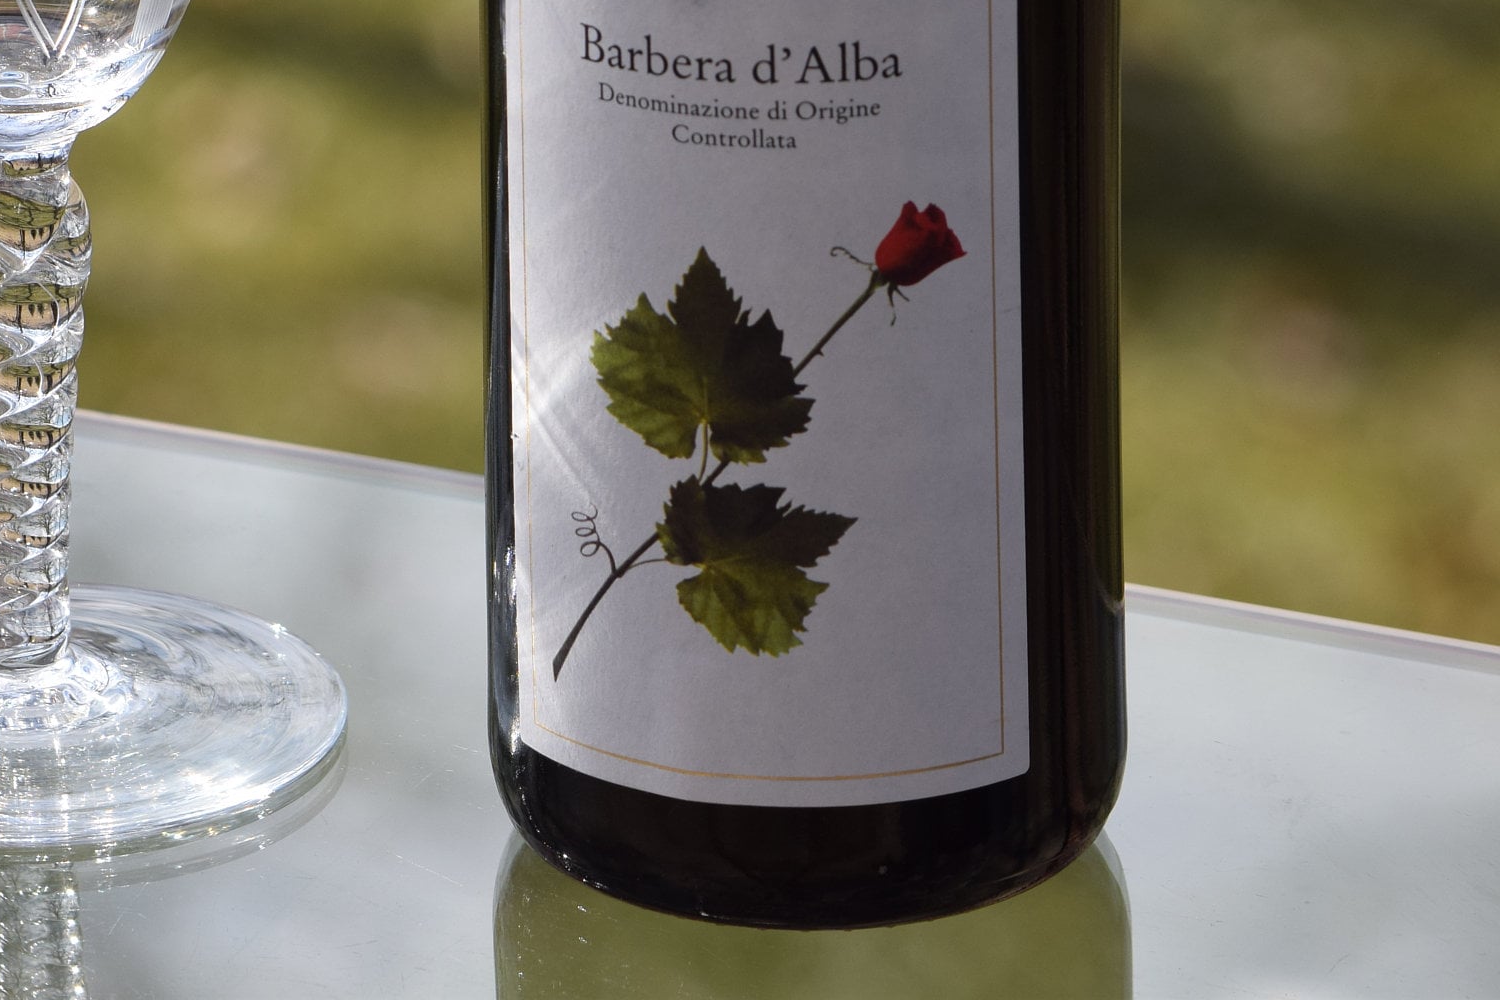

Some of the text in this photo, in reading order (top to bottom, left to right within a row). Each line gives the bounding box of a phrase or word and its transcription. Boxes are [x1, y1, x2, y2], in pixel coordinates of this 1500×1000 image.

[580, 23, 735, 83] Barbera
[599, 83, 881, 125] Denominazione di Origine
[672, 124, 797, 150] Controllata
